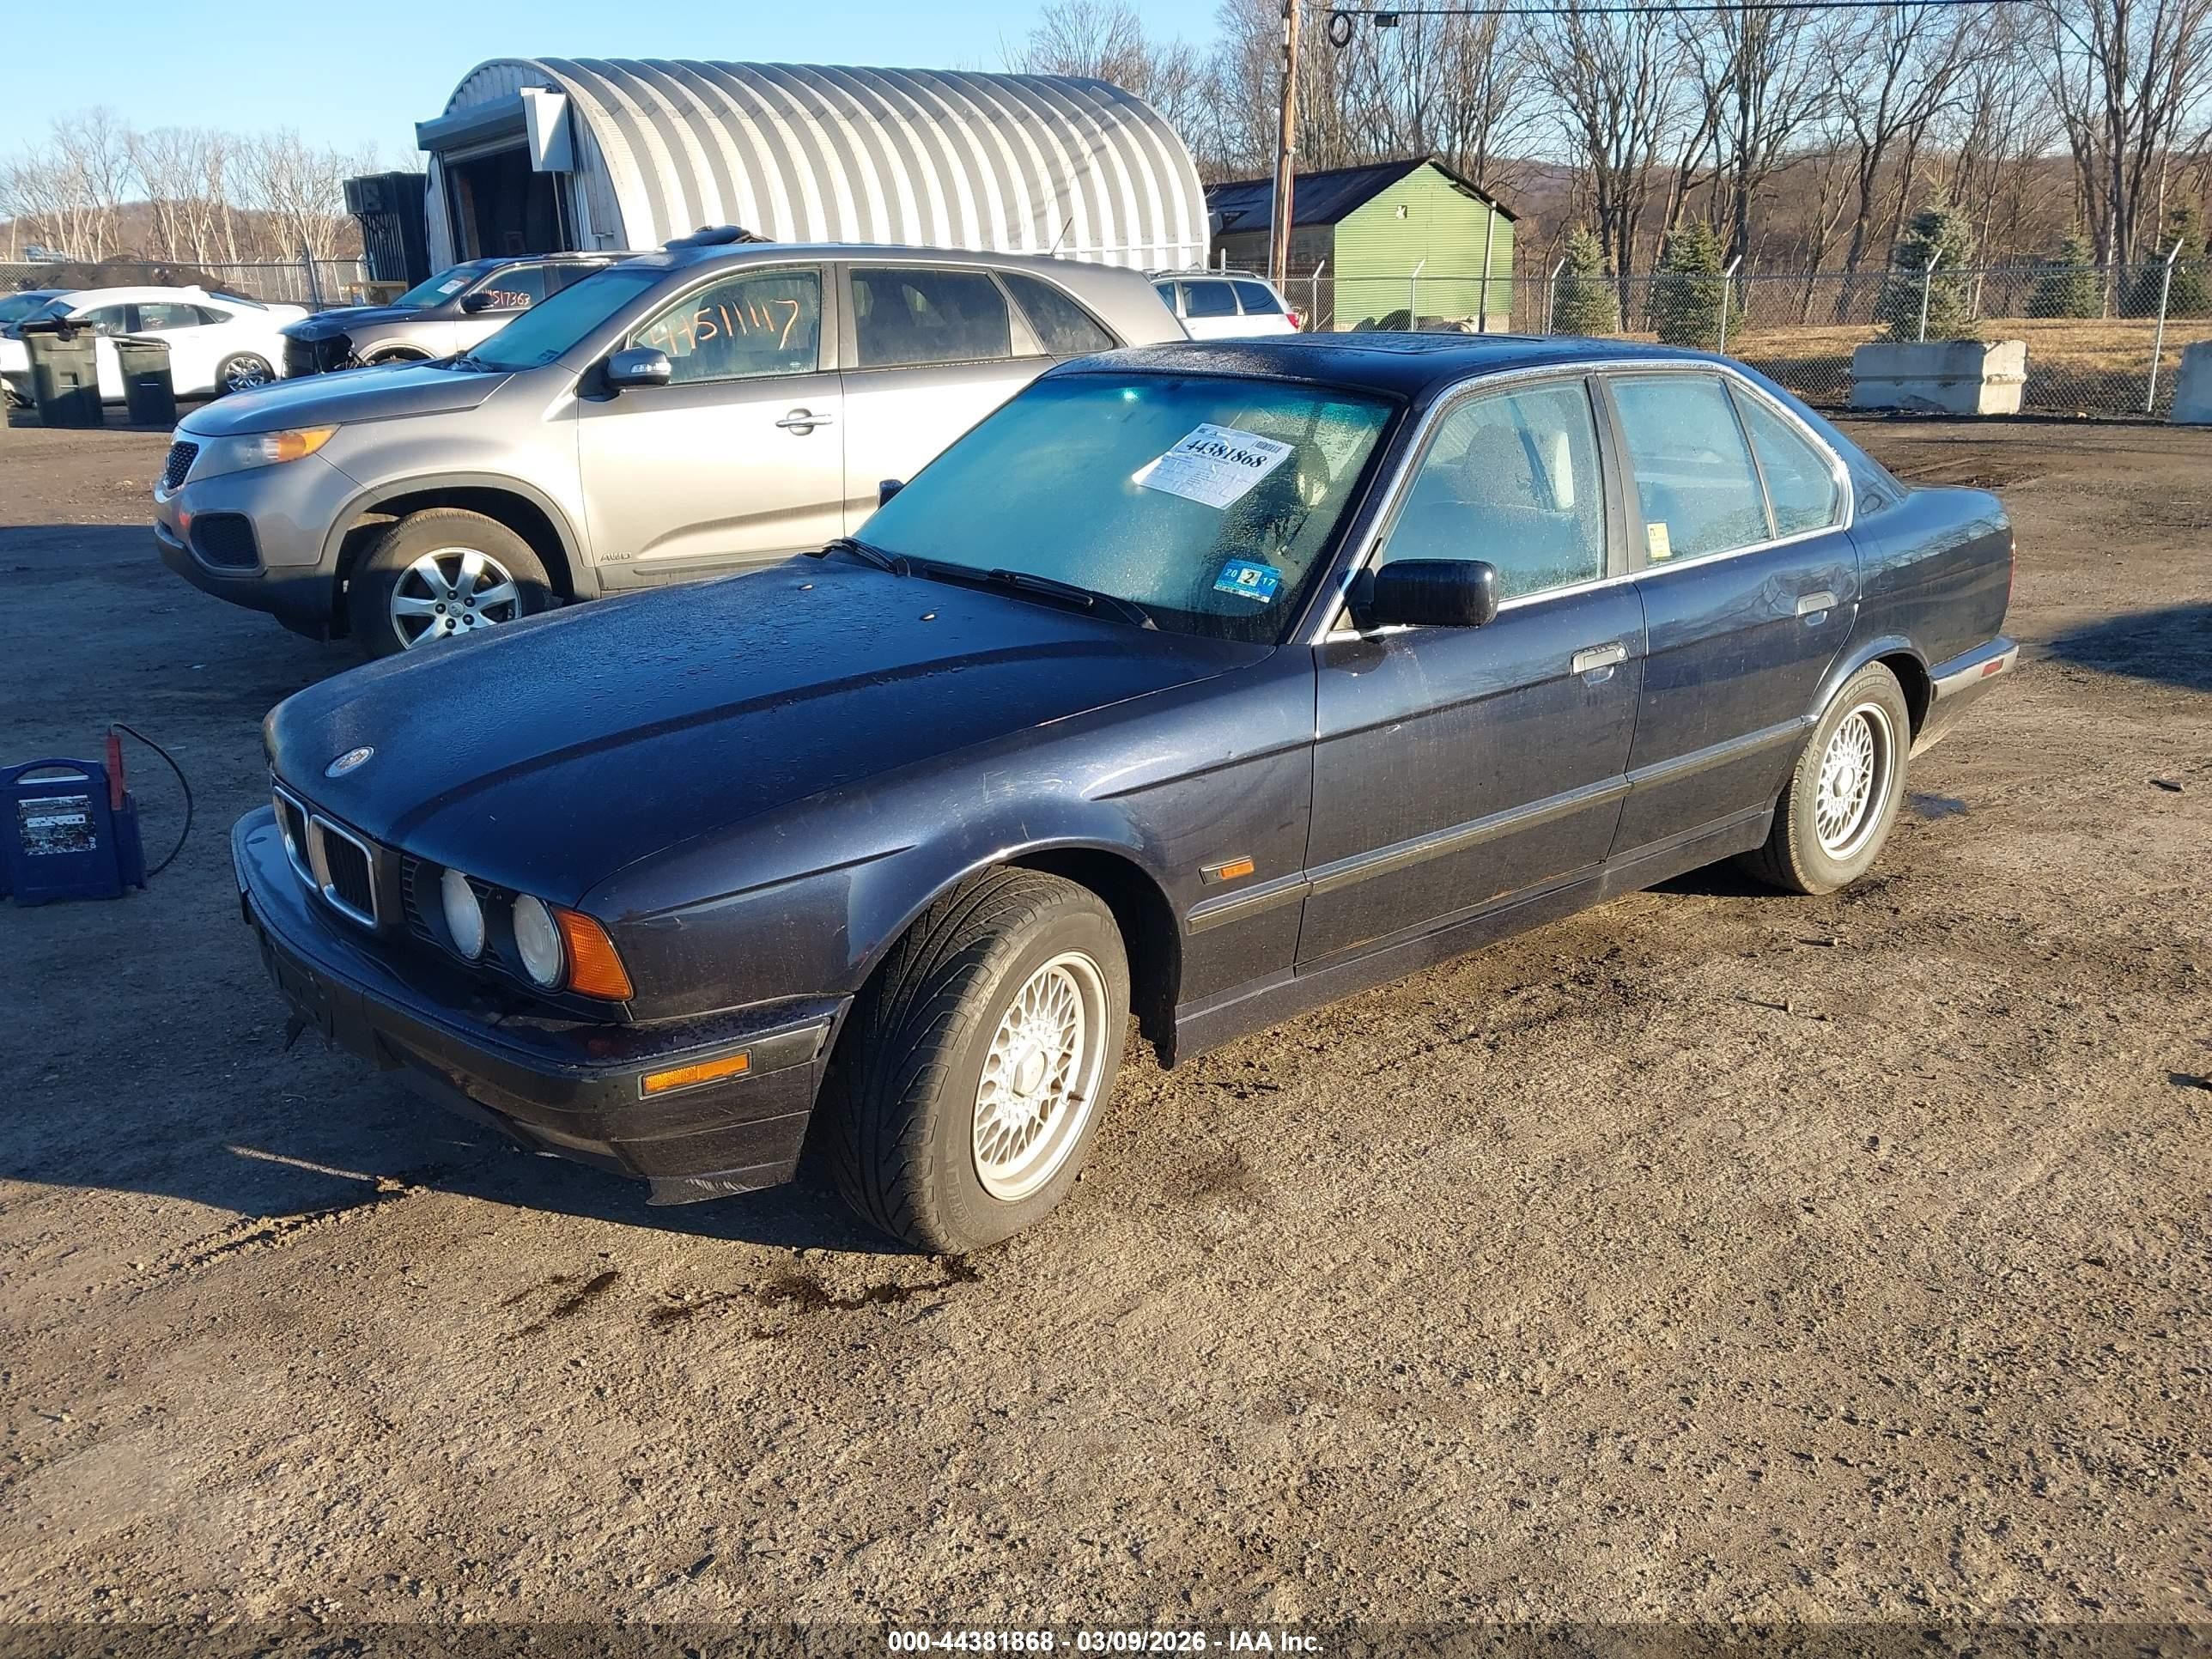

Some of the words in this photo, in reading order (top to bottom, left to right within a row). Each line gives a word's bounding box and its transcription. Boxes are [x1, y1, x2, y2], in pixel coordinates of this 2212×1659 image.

[649, 298, 799, 355] 44511117
[1187, 439, 1267, 468] 44381868
[600, 552, 631, 562] AWD
[1224, 568, 1238, 578] 20
[1243, 571, 1255, 584] 2
[1262, 577, 1276, 586] 17
